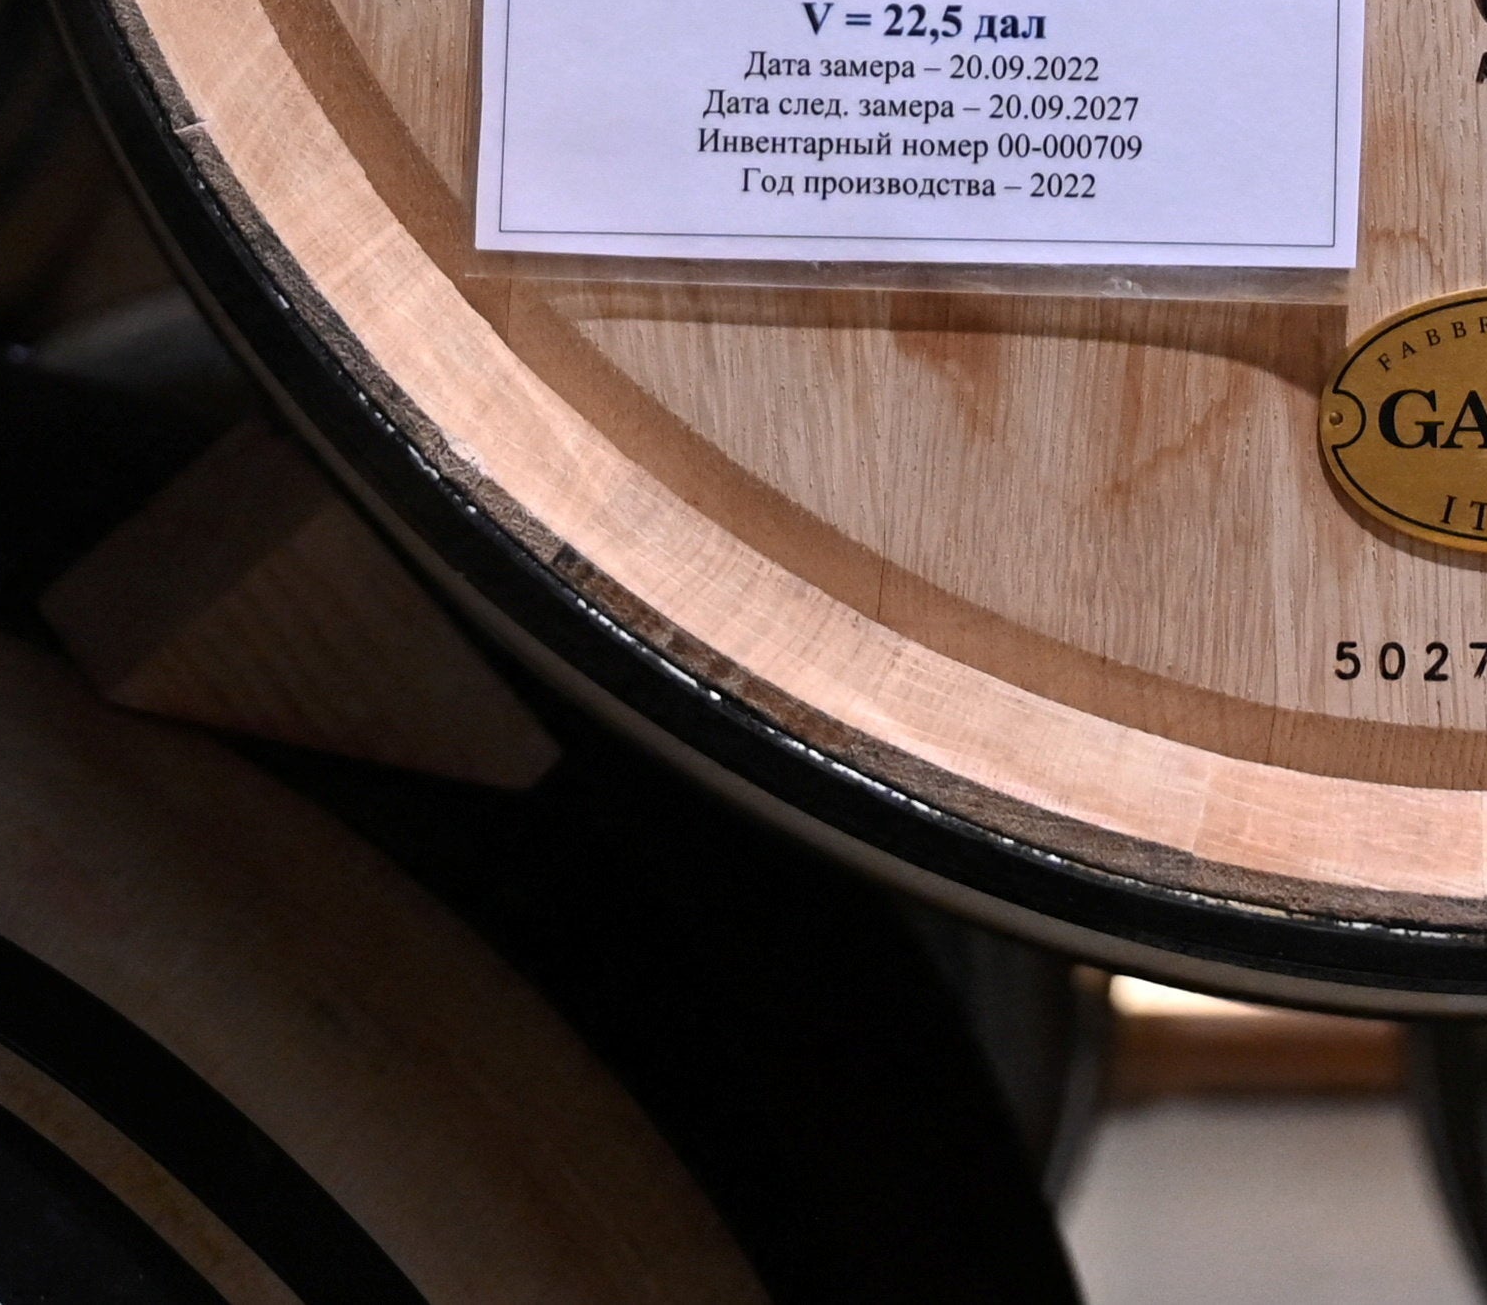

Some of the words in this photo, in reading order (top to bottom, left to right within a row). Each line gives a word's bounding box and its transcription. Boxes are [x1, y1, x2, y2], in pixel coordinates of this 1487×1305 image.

[802, 2, 833, 35] V
[845, 13, 872, 27] =
[884, 3, 962, 43] 22,5
[974, 15, 1045, 43] дал
[744, 51, 811, 80] Дата
[820, 59, 915, 85] замера
[950, 54, 1099, 82] 20.09.2022
[702, 89, 770, 118] Дата
[778, 97, 848, 118] след.
[859, 99, 955, 125] замера
[989, 93, 1139, 121] 20.09.2027
[698, 127, 891, 162] Инвентарный
[902, 139, 989, 165] номер
[997, 133, 1143, 159] 00-000709
[742, 167, 794, 196] Год
[804, 176, 996, 201] производства
[1030, 171, 1096, 199] 2022
